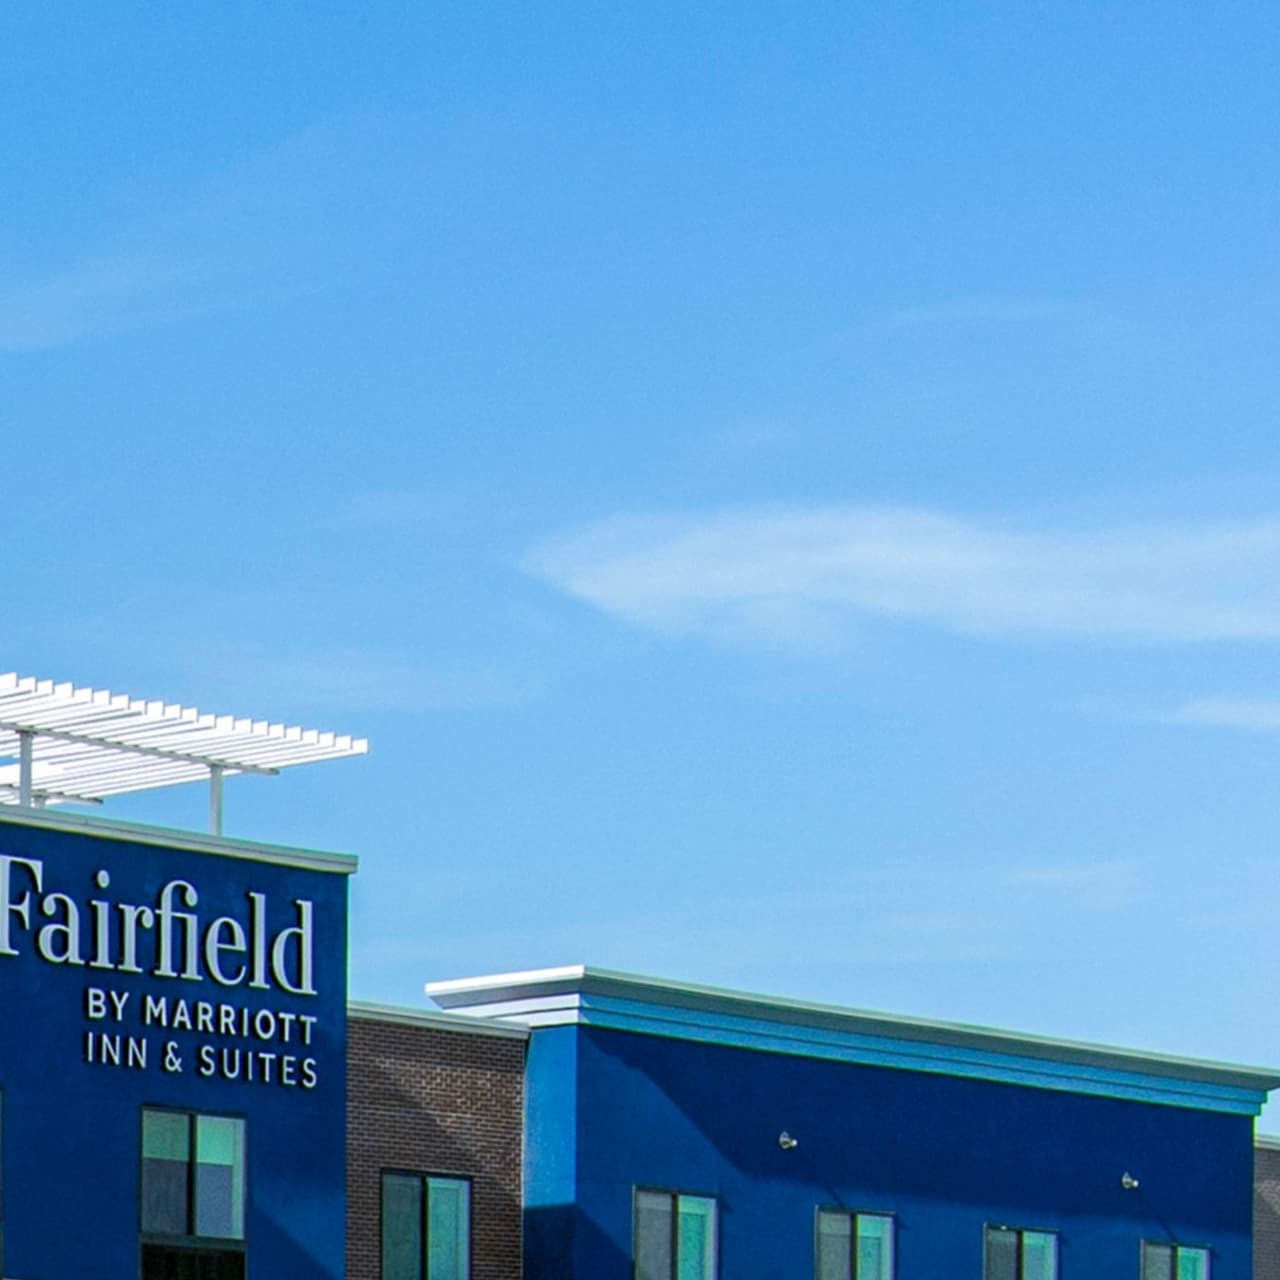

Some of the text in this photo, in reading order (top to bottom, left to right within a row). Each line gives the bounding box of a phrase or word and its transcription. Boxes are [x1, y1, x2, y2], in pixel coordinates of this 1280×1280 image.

[87, 988, 318, 1045] BY MARRIOTT
[87, 1032, 318, 1089] INN & SUITES
